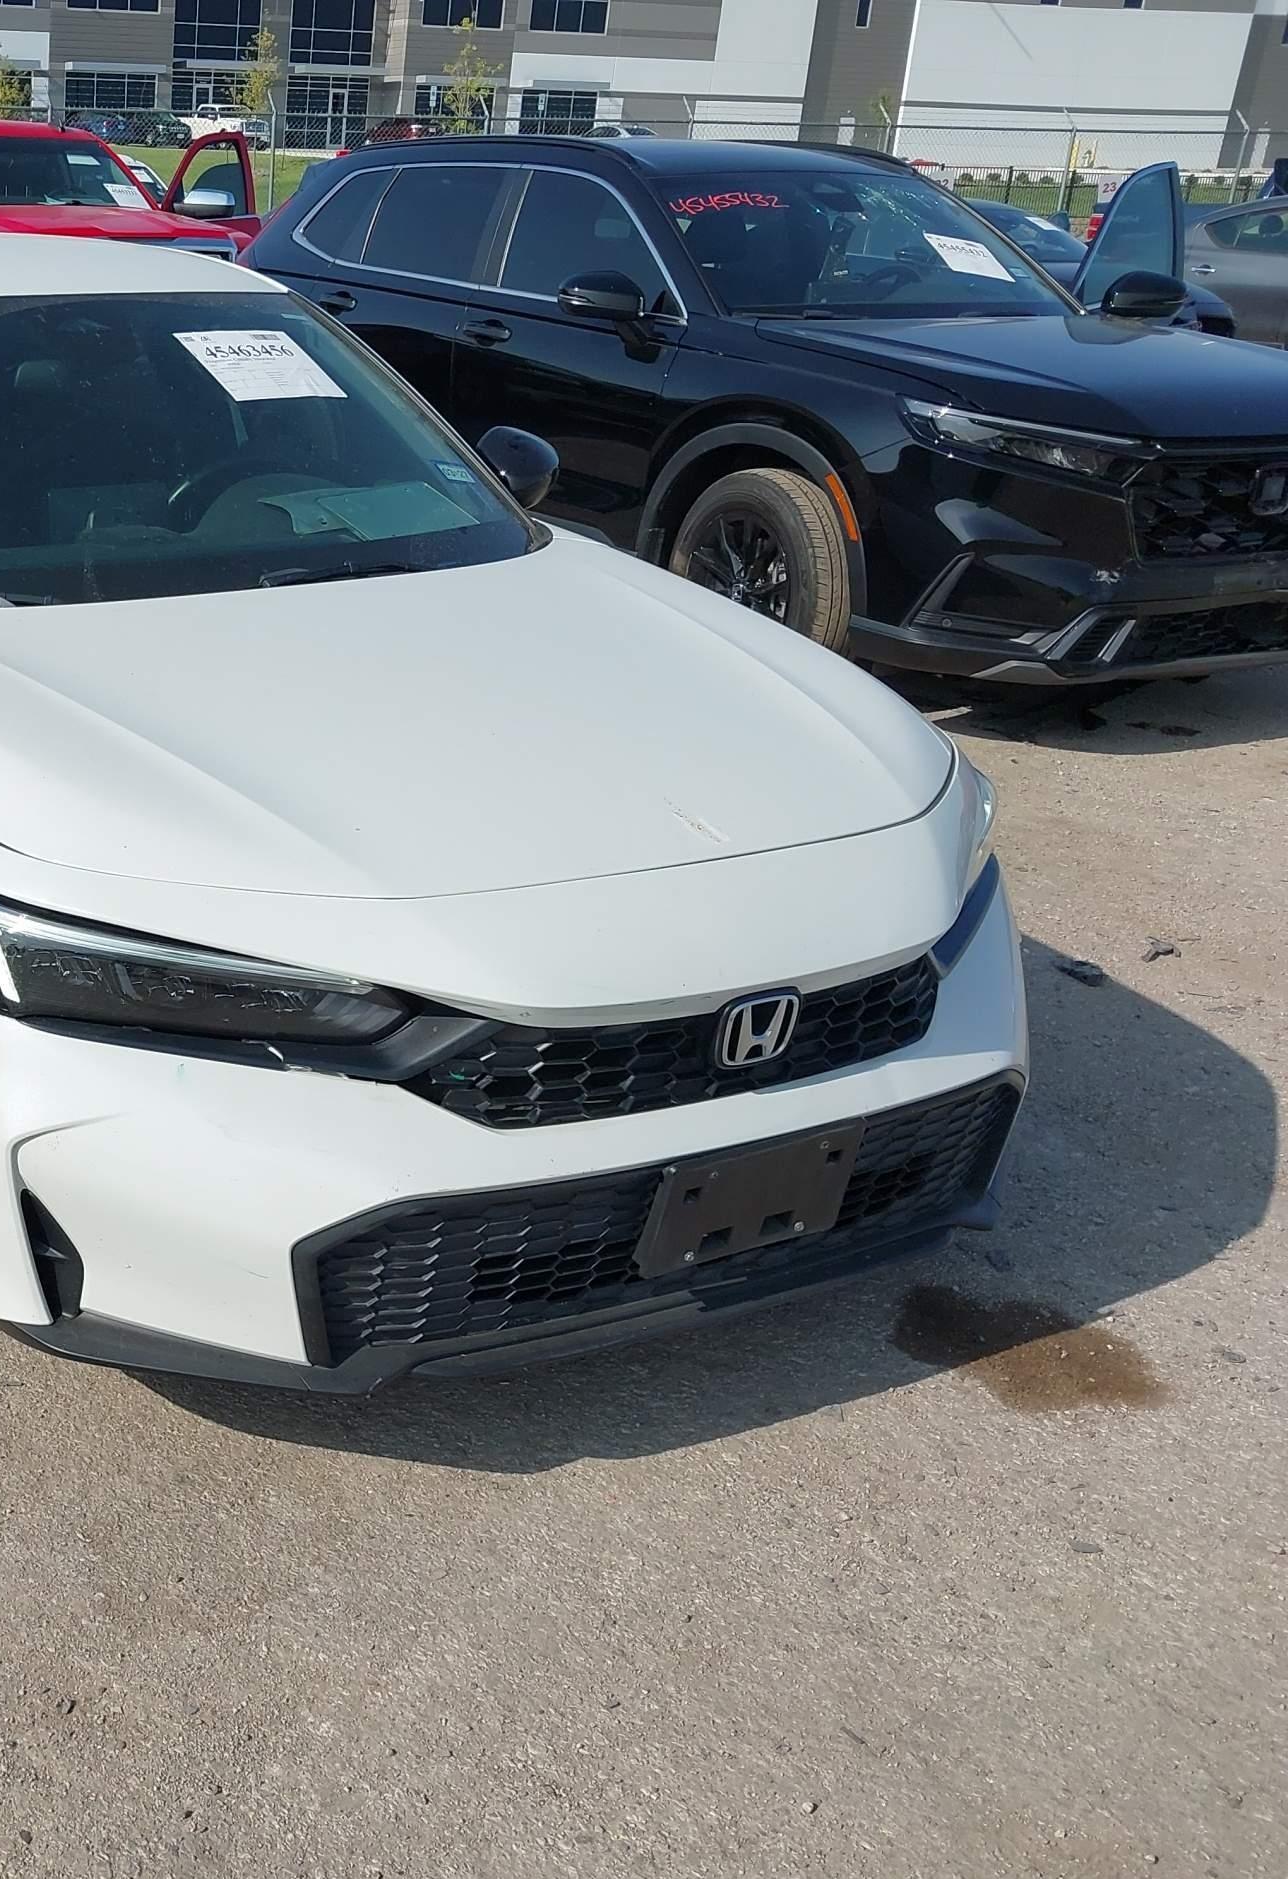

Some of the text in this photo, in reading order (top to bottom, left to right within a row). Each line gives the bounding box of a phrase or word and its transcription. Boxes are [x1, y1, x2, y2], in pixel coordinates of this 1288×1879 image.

[1102, 181, 1118, 194] 23
[668, 191, 791, 215] 45455432
[204, 343, 296, 359] 45463456
